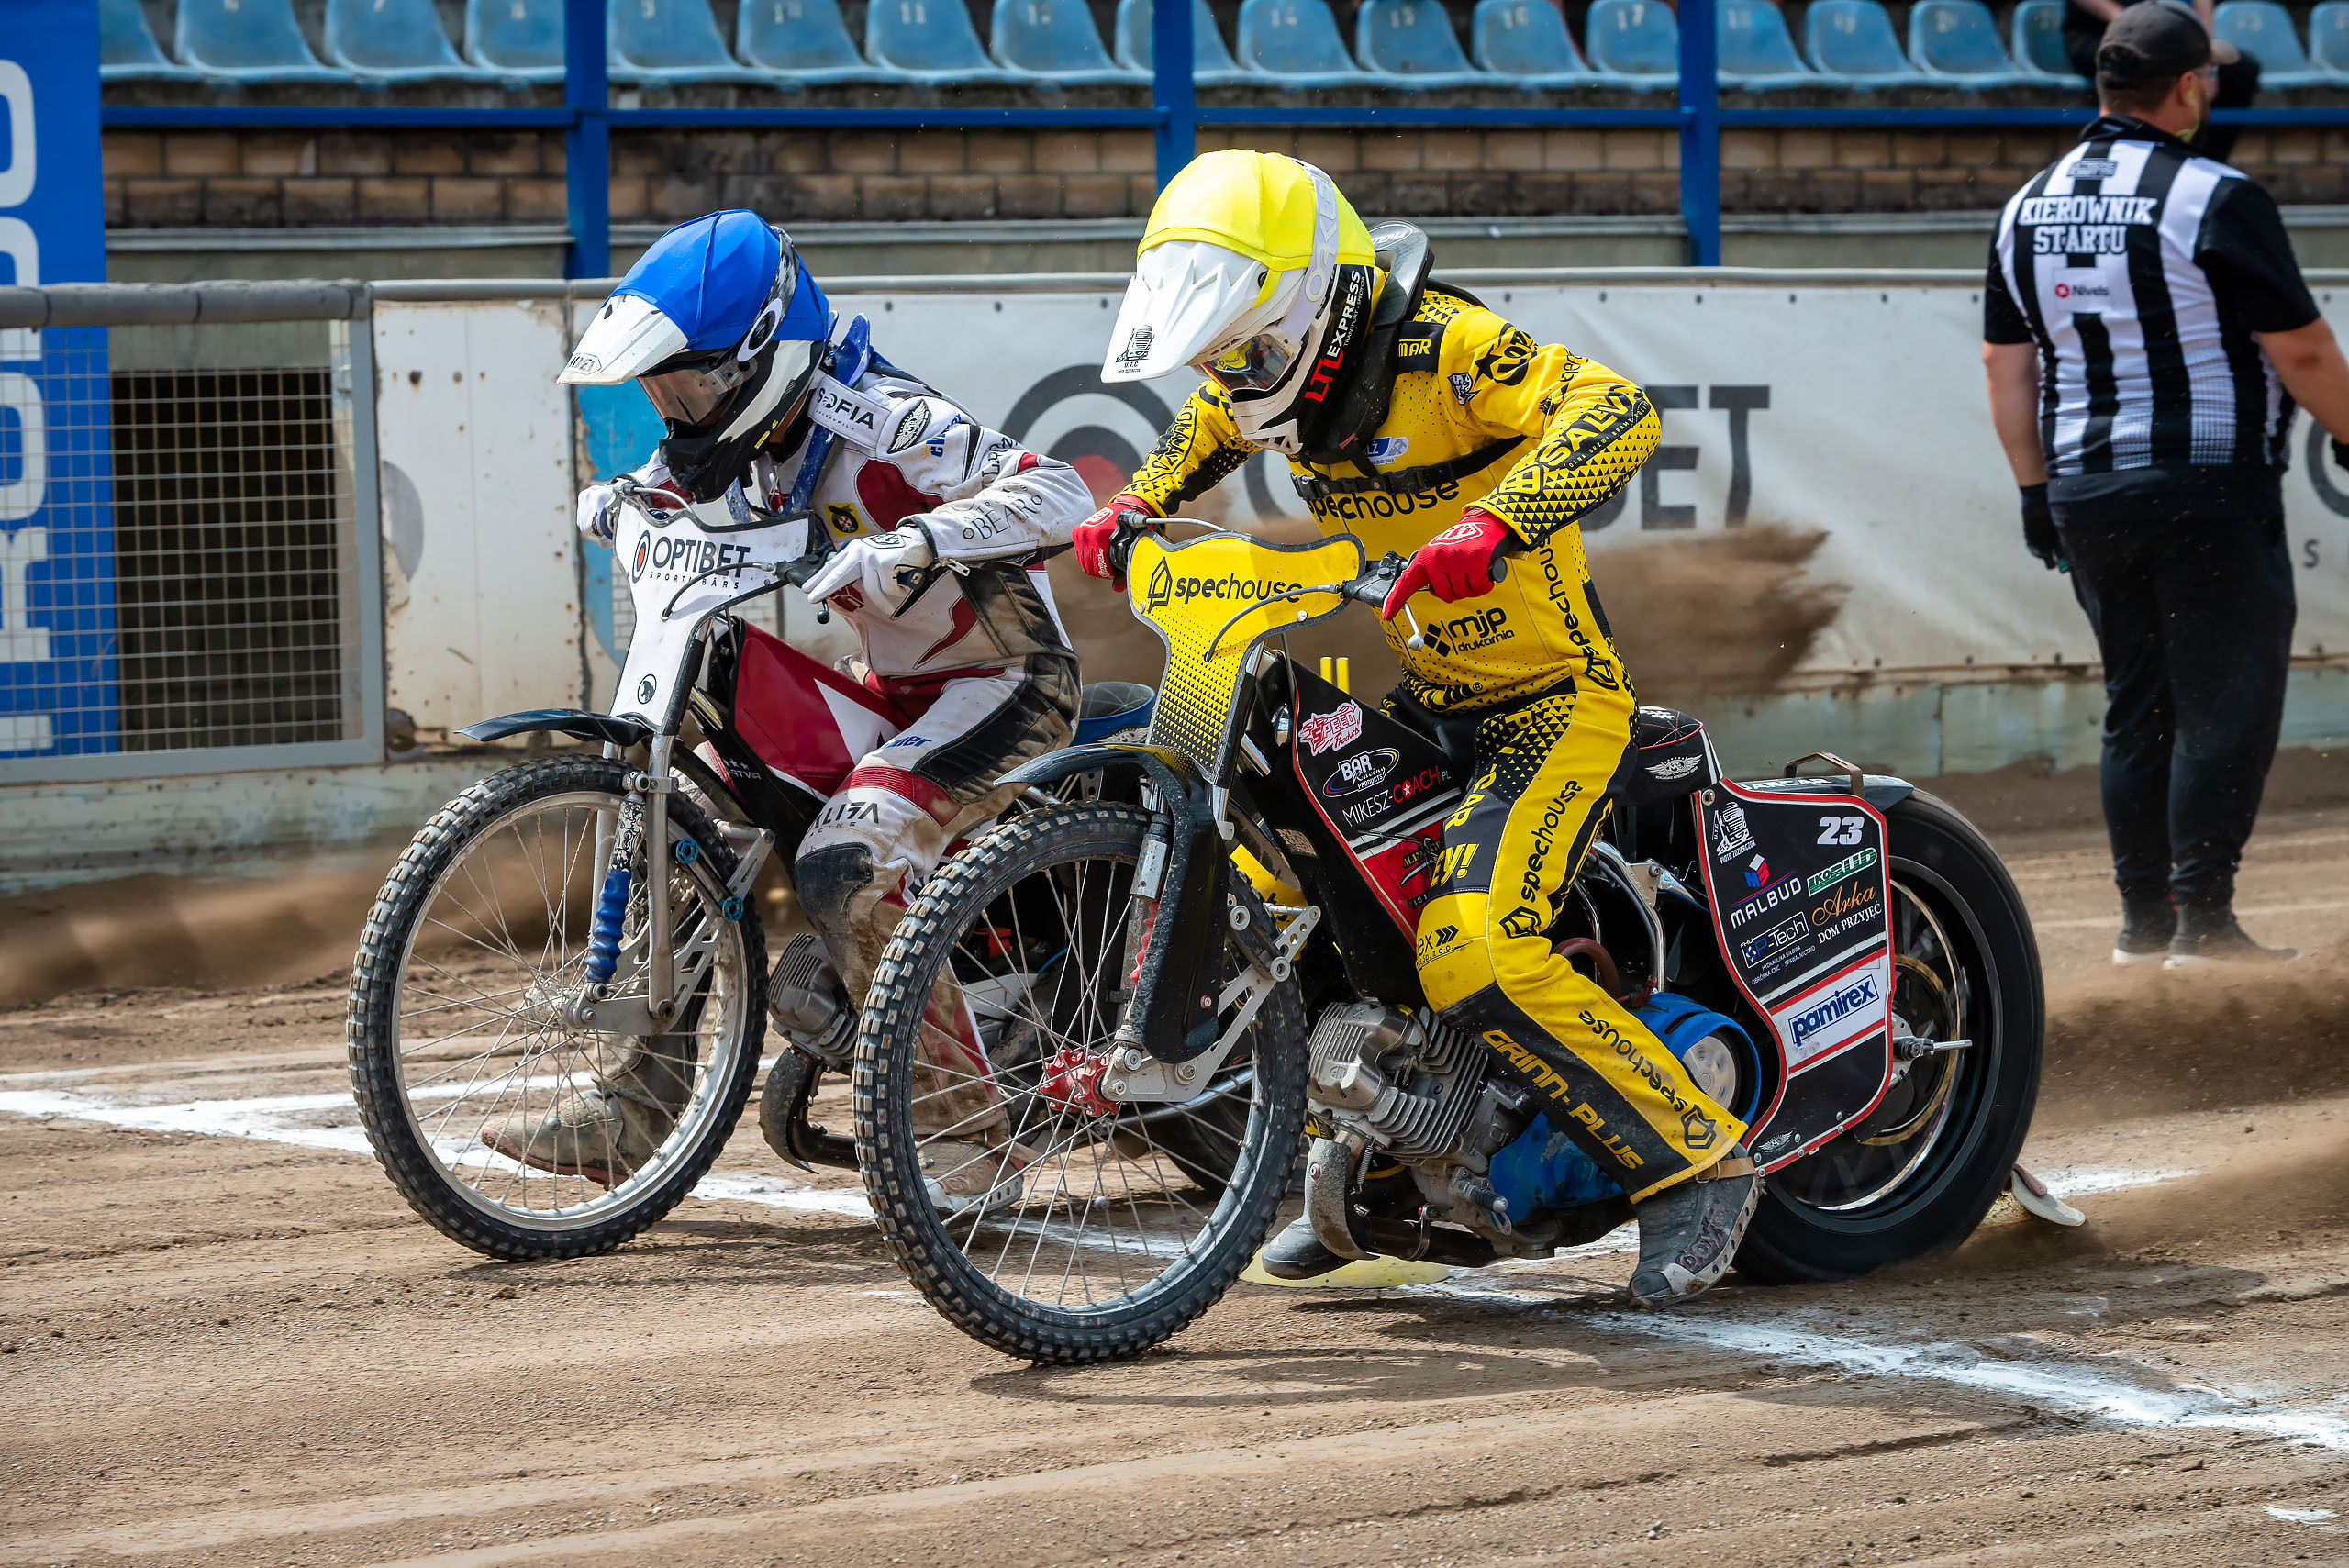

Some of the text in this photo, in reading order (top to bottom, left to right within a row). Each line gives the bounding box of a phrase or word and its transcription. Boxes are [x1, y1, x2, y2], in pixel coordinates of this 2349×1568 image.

[900, 2, 927, 25] 11
[2018, 195, 2158, 226] KIEROWNIK
[2033, 225, 2128, 254] STARTU
[1327, 270, 1361, 358] EXPRESS
[1344, 312, 1359, 346] TRANSPORT
[816, 386, 874, 430] SOFIA
[972, 498, 1039, 540] BEAR
[652, 536, 751, 578] OPTIBET
[1175, 573, 1303, 604] spechouse
[1447, 607, 1507, 639] mjp
[1458, 629, 1515, 652] drukarnia
[1311, 714, 1356, 745] SPEED
[1334, 727, 1361, 749] Products
[1341, 754, 1373, 781] BAR
[1353, 766, 1386, 784] Racing
[1357, 774, 1385, 790] PRODUCTS
[1521, 780, 1583, 903] spechouse
[1816, 816, 1865, 845] 23
[1730, 877, 1802, 929] MALBUD
[1811, 881, 1876, 926] Arka
[1818, 900, 1883, 944] DOM PRZYJĘĆ
[1751, 970, 1773, 985] OBRÓBKA
[1771, 964, 1782, 976] CNC
[1761, 952, 1786, 971] HYDRAULIKA
[1792, 981, 1876, 1047] pamirex
[1578, 1010, 1688, 1112] spechouse
